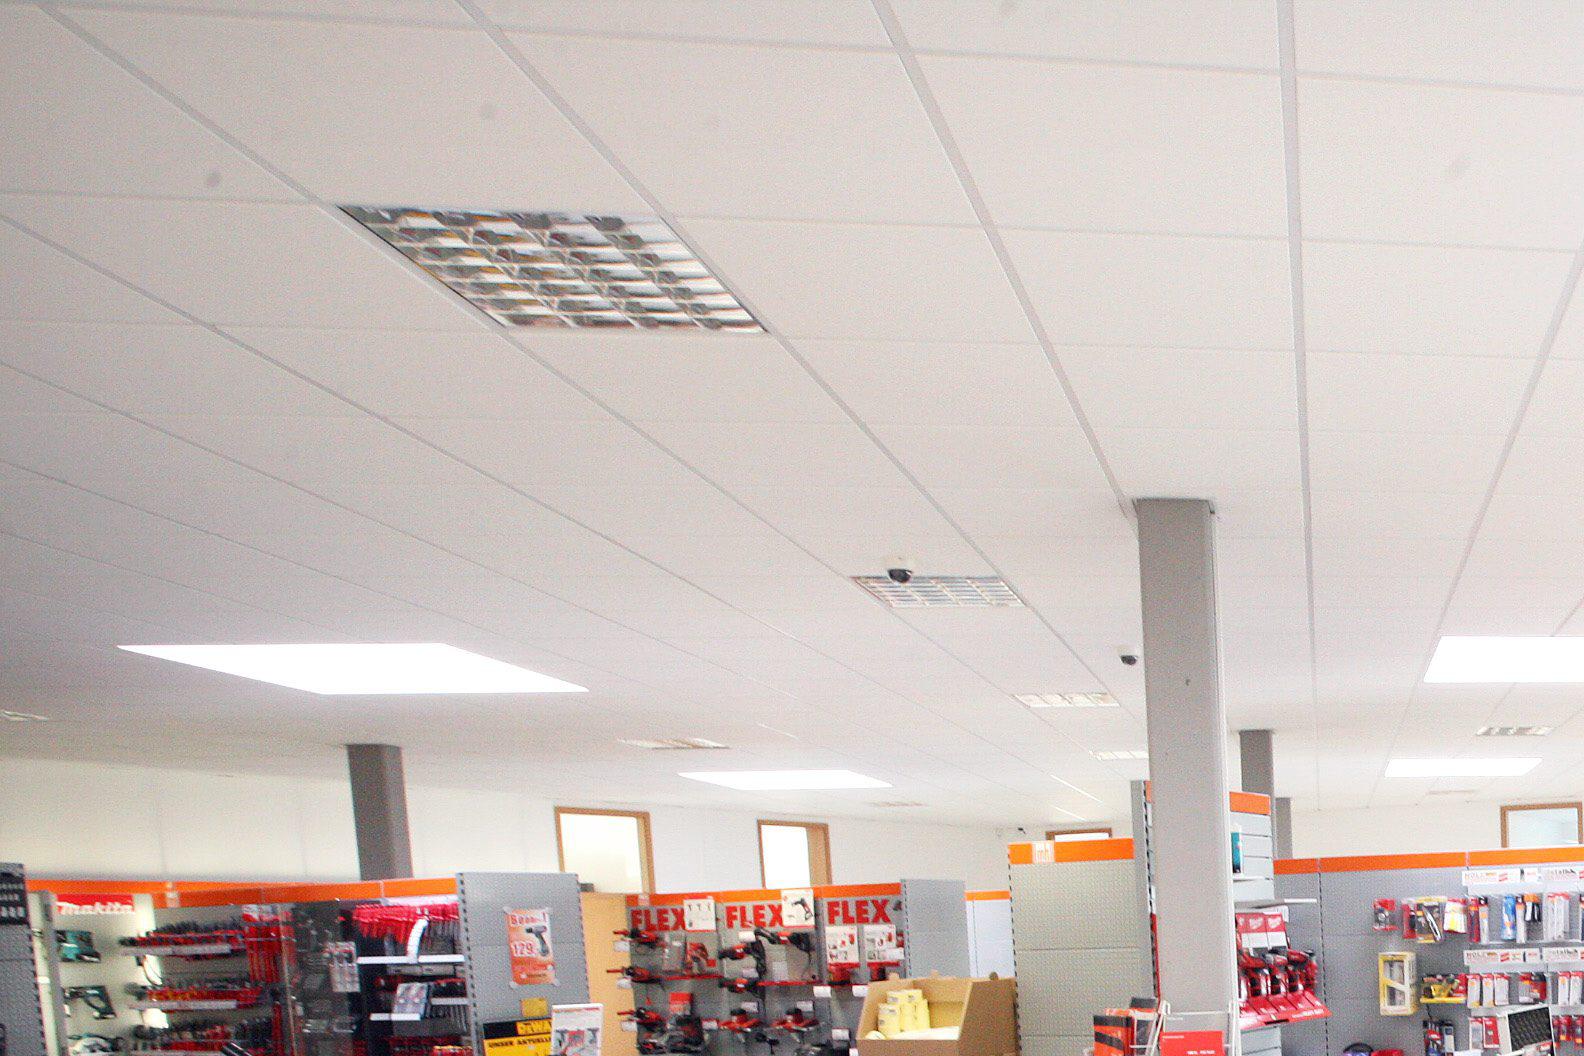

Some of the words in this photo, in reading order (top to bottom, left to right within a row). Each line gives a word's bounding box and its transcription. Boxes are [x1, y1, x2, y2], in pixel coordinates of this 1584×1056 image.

[630, 908, 685, 931] FLEX
[726, 905, 784, 929] FLEX
[828, 899, 892, 925] FLEX
